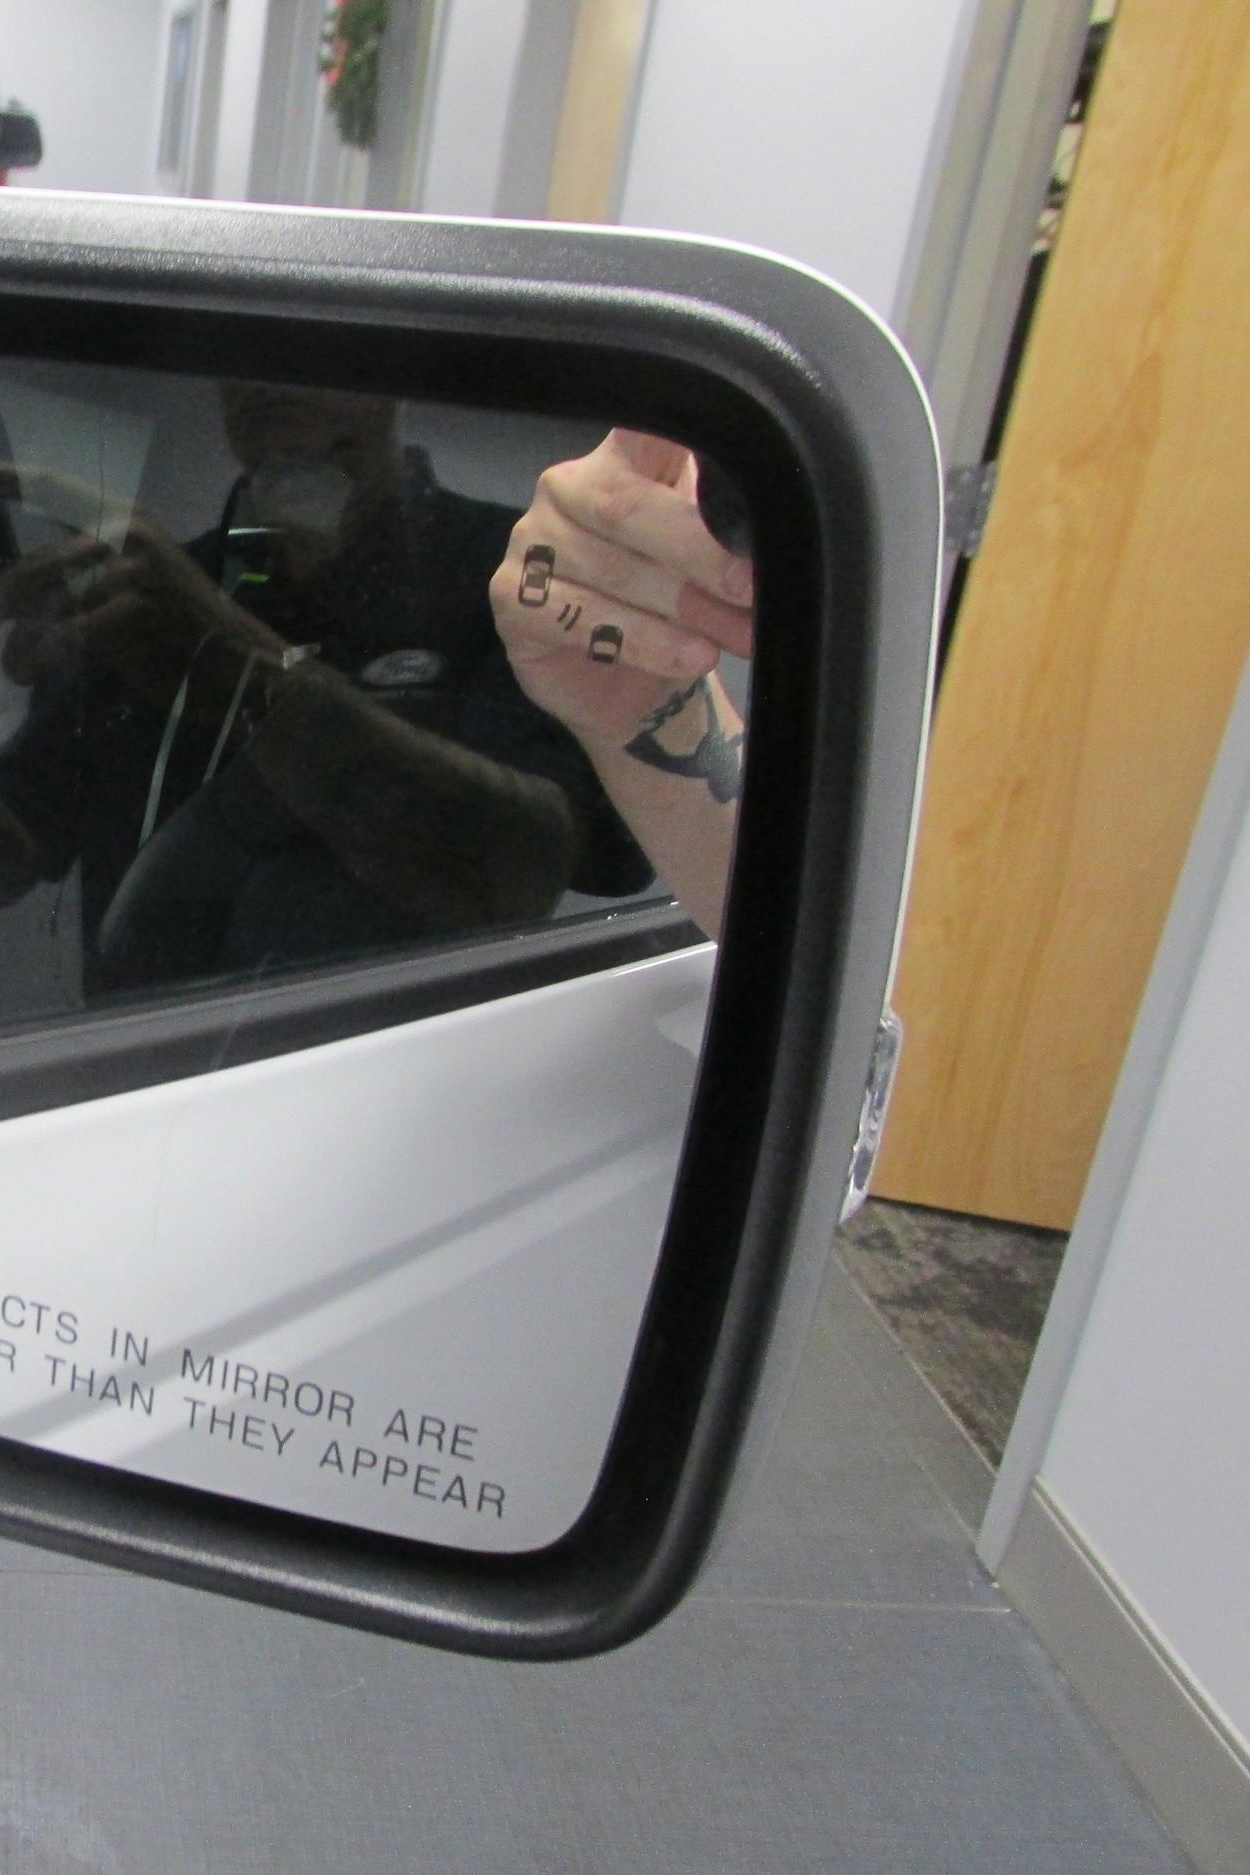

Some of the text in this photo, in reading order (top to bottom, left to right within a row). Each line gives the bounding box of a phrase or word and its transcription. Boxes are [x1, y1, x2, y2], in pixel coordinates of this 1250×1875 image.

[45, 1355, 155, 1417] THAN
[183, 1396, 295, 1457] THEY
[318, 1440, 506, 1519] APPEAR
[110, 1327, 150, 1367] IN
[180, 1347, 355, 1428] MIRROR
[383, 1408, 479, 1461] ARE
